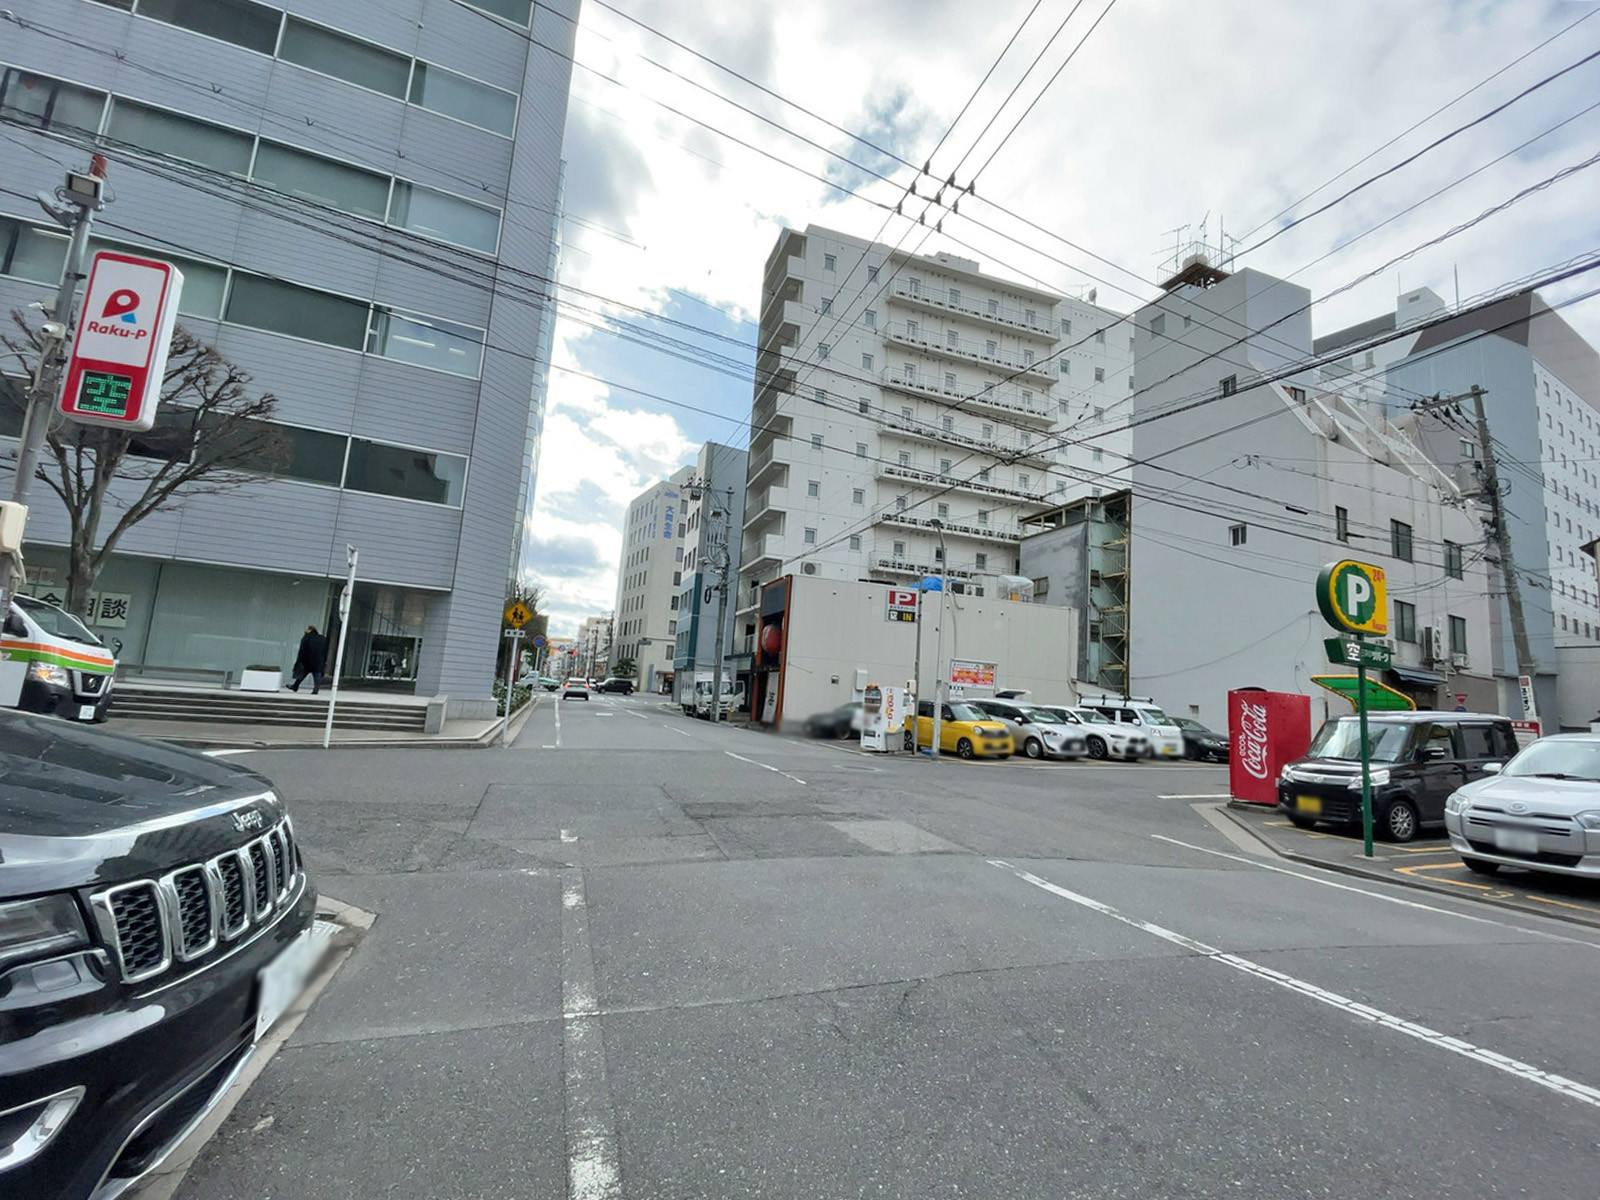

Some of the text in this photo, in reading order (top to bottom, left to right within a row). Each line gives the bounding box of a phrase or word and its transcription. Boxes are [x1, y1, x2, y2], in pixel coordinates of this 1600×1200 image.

[87, 320, 148, 340] Raku-P
[79, 374, 133, 416] 空
[894, 592, 912, 605] P
[1347, 573, 1371, 616] P
[902, 612, 913, 622] IN
[1346, 642, 1361, 661] 空
[231, 809, 262, 832] Jeep
